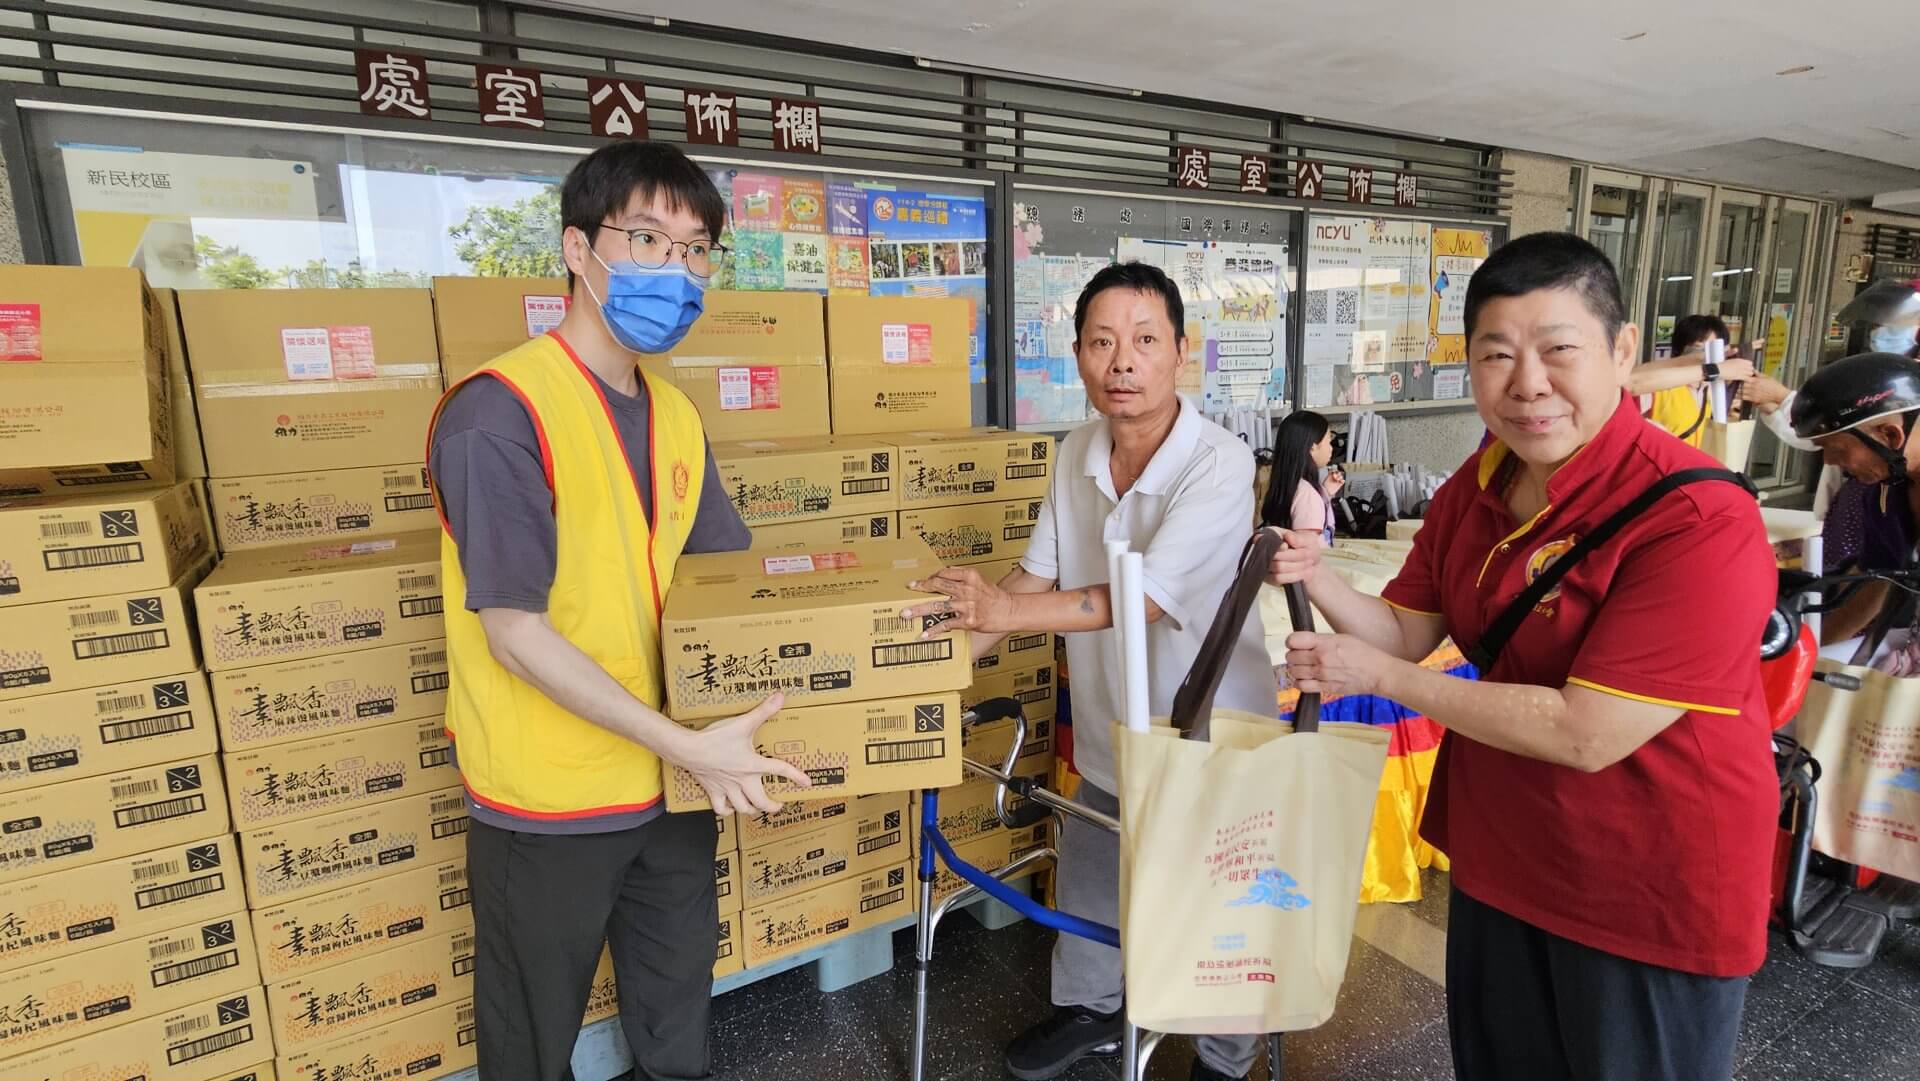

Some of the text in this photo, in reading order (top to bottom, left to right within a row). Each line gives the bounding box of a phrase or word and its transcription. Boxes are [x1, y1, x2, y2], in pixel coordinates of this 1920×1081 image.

[360, 53, 820, 152] 處室公佈欄
[87, 169, 172, 189] 新民校區
[1180, 150, 1416, 207] 處室公佈欄
[121, 511, 133, 524] 2
[235, 498, 309, 531] 素飄香
[106, 524, 118, 536] 3
[147, 600, 159, 611] 2
[133, 612, 145, 624] 3
[224, 605, 311, 647] 素飄香
[784, 646, 806, 657] 全素
[686, 648, 777, 693] 素飄香
[173, 684, 184, 694] 2
[159, 696, 170, 707] 3
[240, 685, 325, 728] 素飄香
[932, 706, 941, 717] 2
[918, 718, 927, 730] 3
[186, 767, 196, 778] 2
[171, 780, 182, 791] 3
[251, 763, 335, 807] 素飄香
[206, 845, 216, 857] 2
[192, 859, 202, 869] 3
[266, 838, 348, 882] 素飄香
[754, 855, 806, 890] 素飄香
[220, 923, 230, 934] 2
[757, 913, 809, 949] 素飄香
[207, 936, 217, 947] 3
[278, 913, 358, 958] 素飄香
[235, 998, 245, 1009] 2
[294, 982, 373, 1029] 素飄香
[222, 1012, 233, 1023] 3
